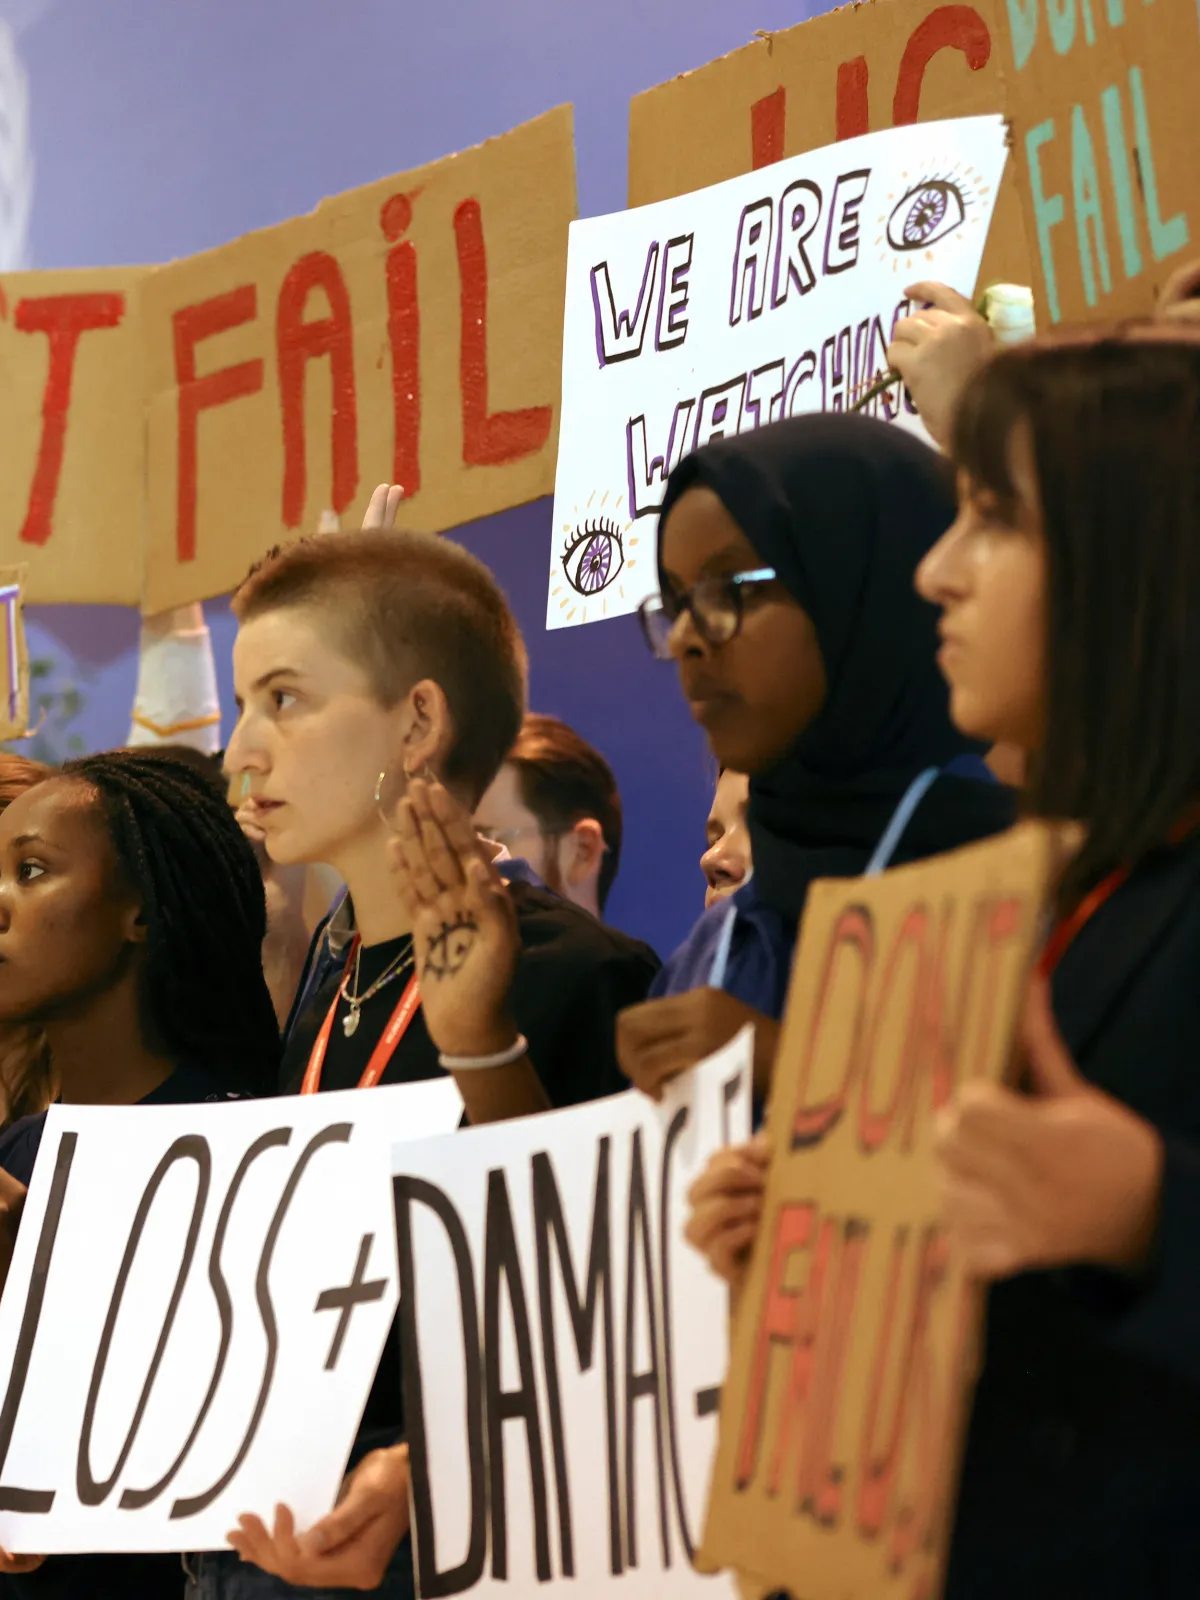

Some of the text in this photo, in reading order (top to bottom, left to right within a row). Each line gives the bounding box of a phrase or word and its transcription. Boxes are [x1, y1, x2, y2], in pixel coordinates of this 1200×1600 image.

[589, 168, 872, 369] WE ARE
[1025, 66, 1190, 325] FAIL
[626, 298, 920, 519] WATCHIN
[392, 1076, 742, 1600] DAMAG
